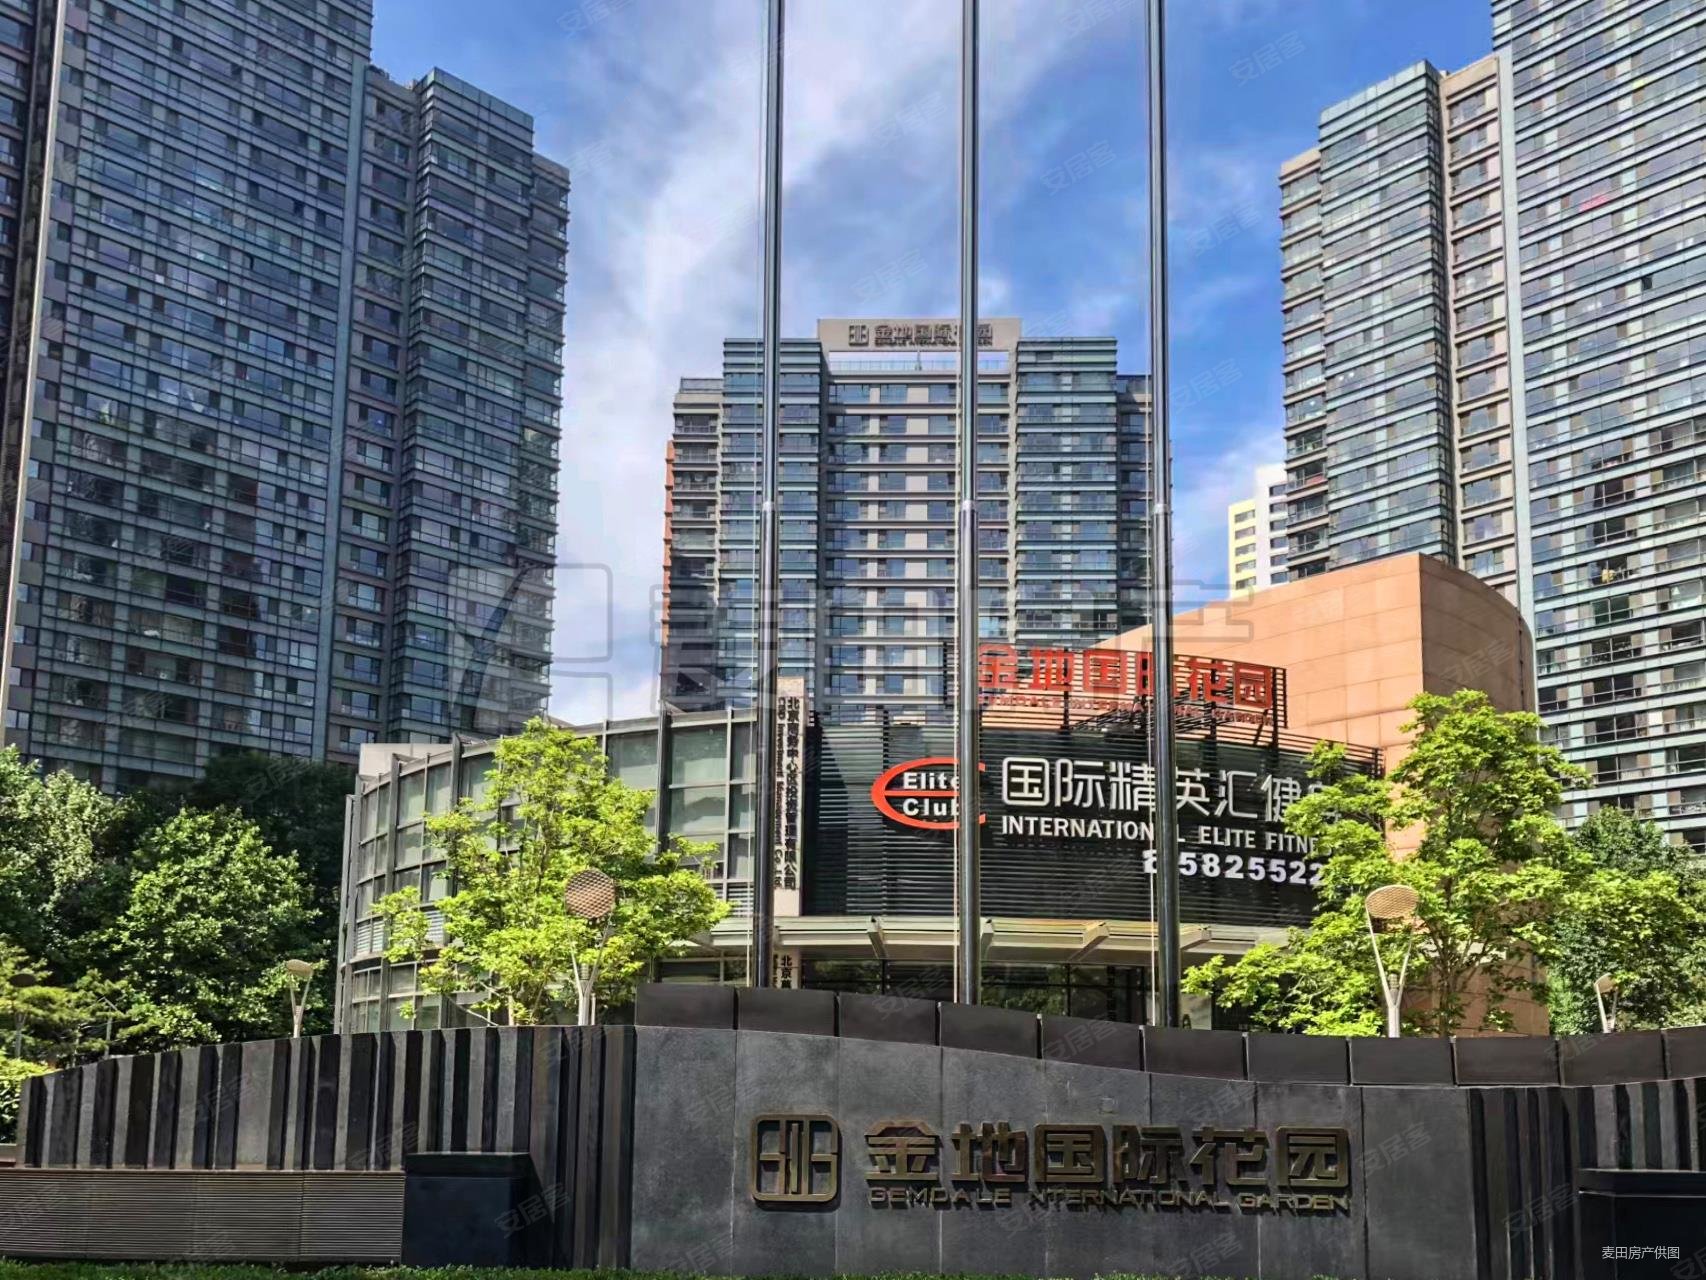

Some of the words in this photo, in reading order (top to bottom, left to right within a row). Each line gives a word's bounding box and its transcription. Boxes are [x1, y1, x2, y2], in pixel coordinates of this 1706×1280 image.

[1002, 815, 1186, 842] INTERNATIONL
[1199, 825, 1256, 848] ELITE
[865, 1119, 1351, 1188] 金地国际花园
[868, 1186, 1011, 1203] GEMDALE
[1236, 1191, 1351, 1211] GARDEN
